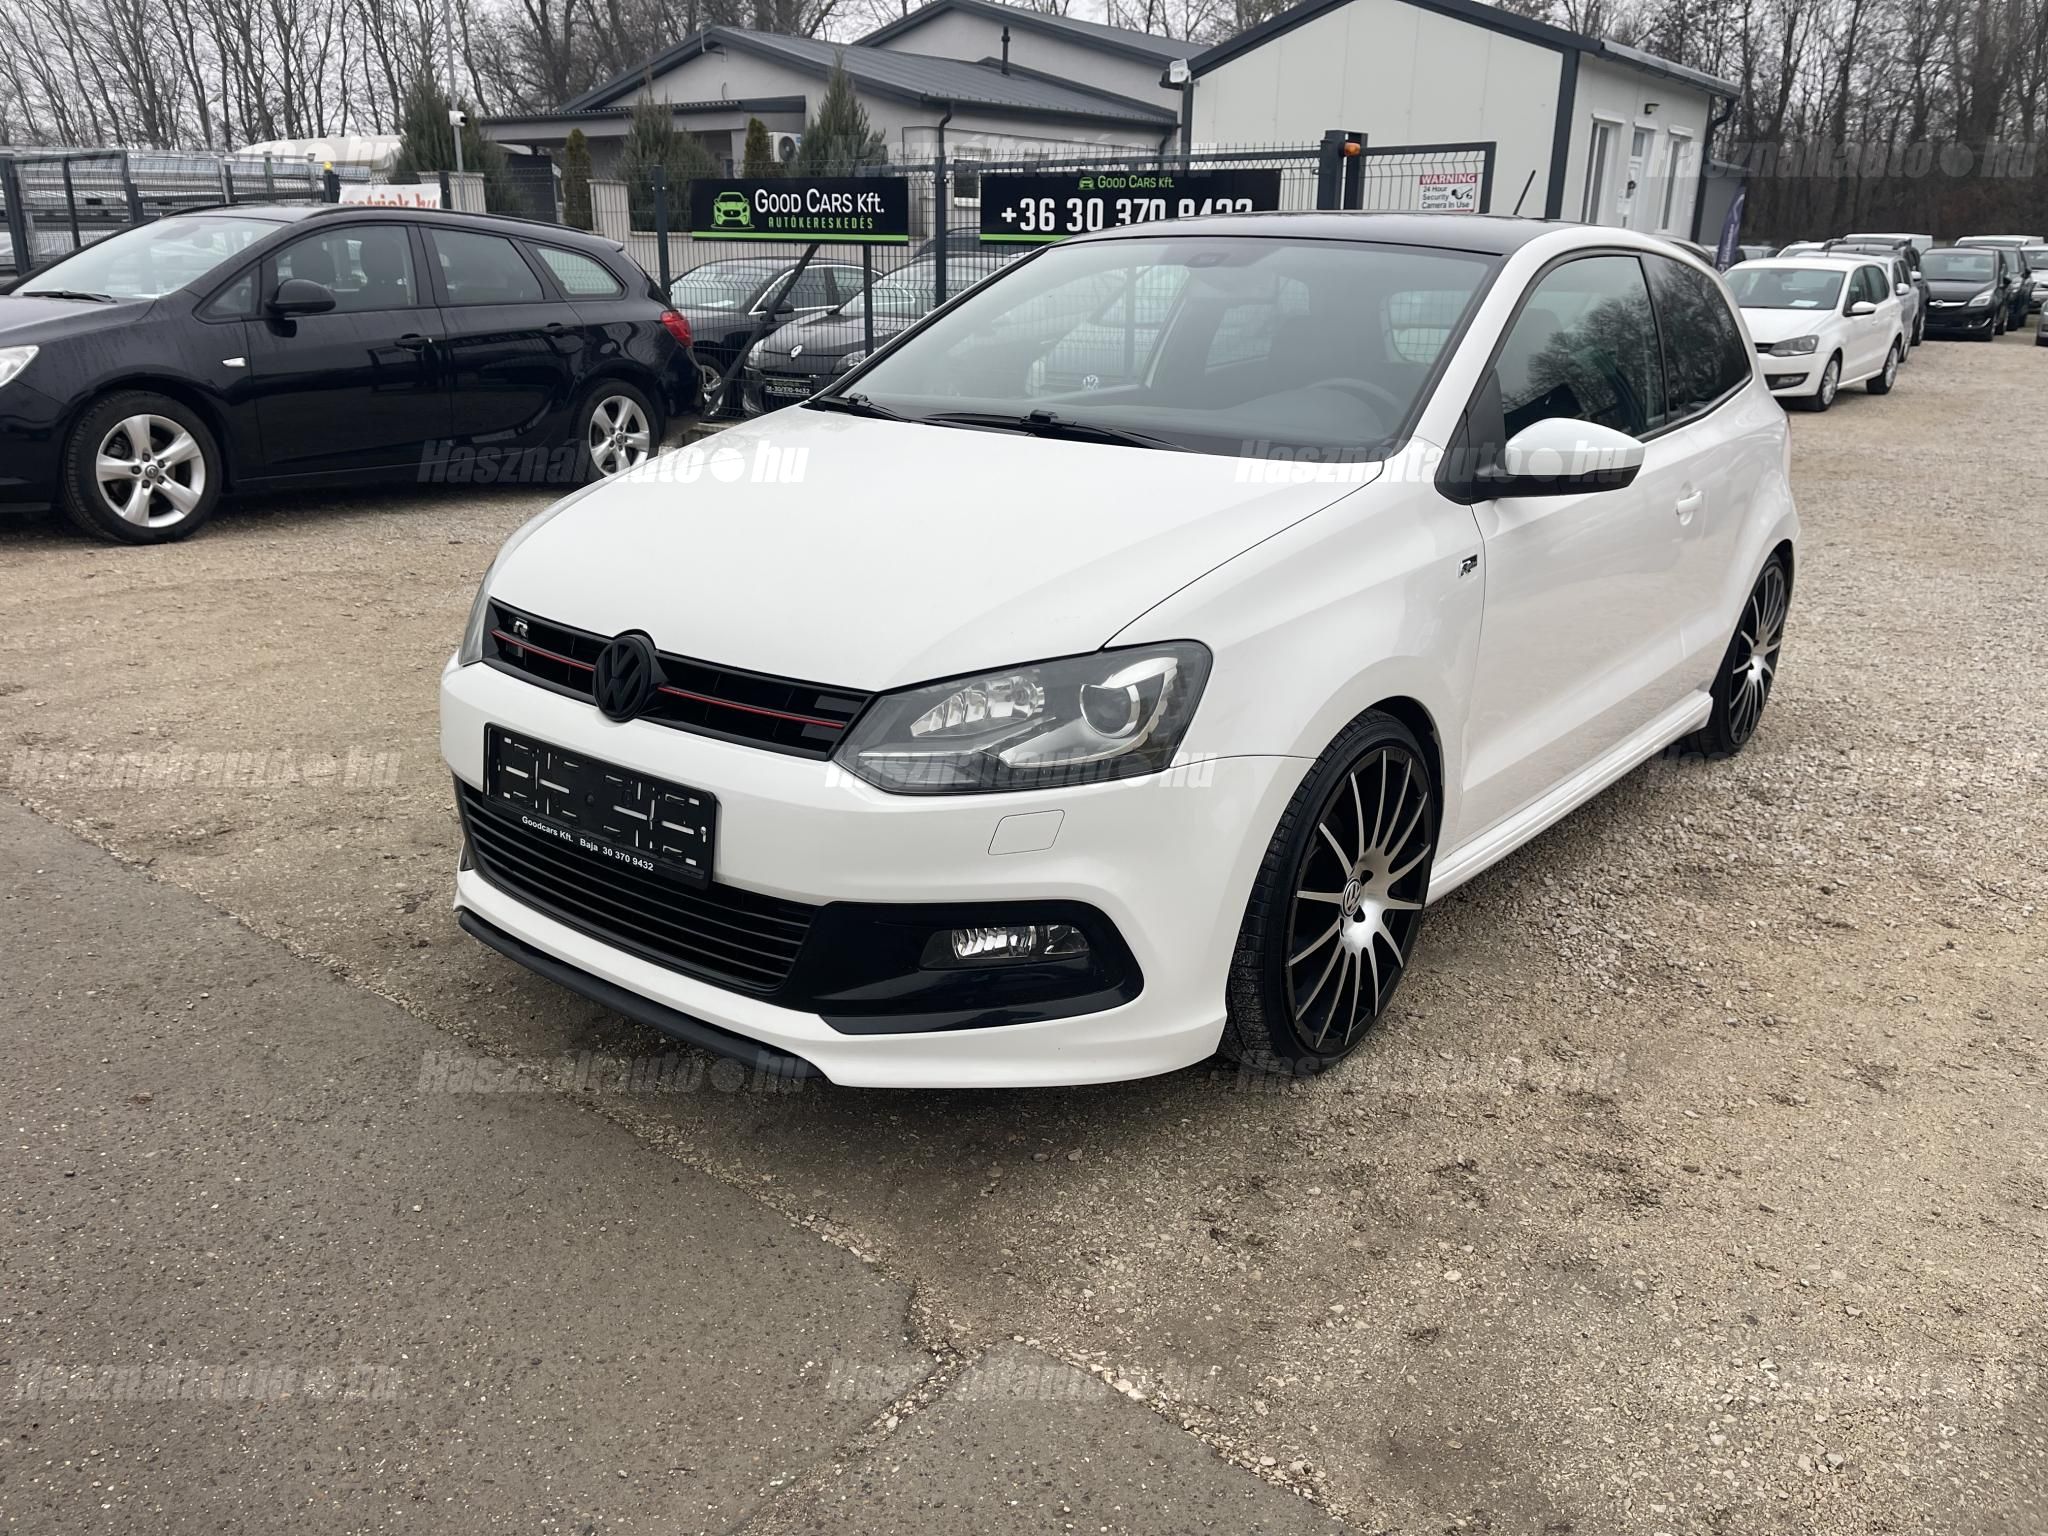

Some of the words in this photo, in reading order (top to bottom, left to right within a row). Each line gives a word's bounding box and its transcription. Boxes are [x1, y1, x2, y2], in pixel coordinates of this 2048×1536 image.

[1422, 173, 1476, 185] WARNING
[754, 188, 801, 213] GOOD
[806, 188, 853, 213] CARS
[857, 192, 885, 214] Kft.
[1422, 193, 1449, 201] Security
[768, 215, 874, 229] AUTÓKERESKEDÉS
[1001, 198, 1056, 232] +36
[1066, 198, 1104, 232] 30
[512, 619, 529, 638] R
[521, 815, 558, 837] Goodcars
[559, 829, 574, 843] Kft.
[579, 838, 599, 852] Baja
[602, 846, 613, 858] 30
[615, 850, 631, 864] 370
[632, 854, 654, 872] 9432
